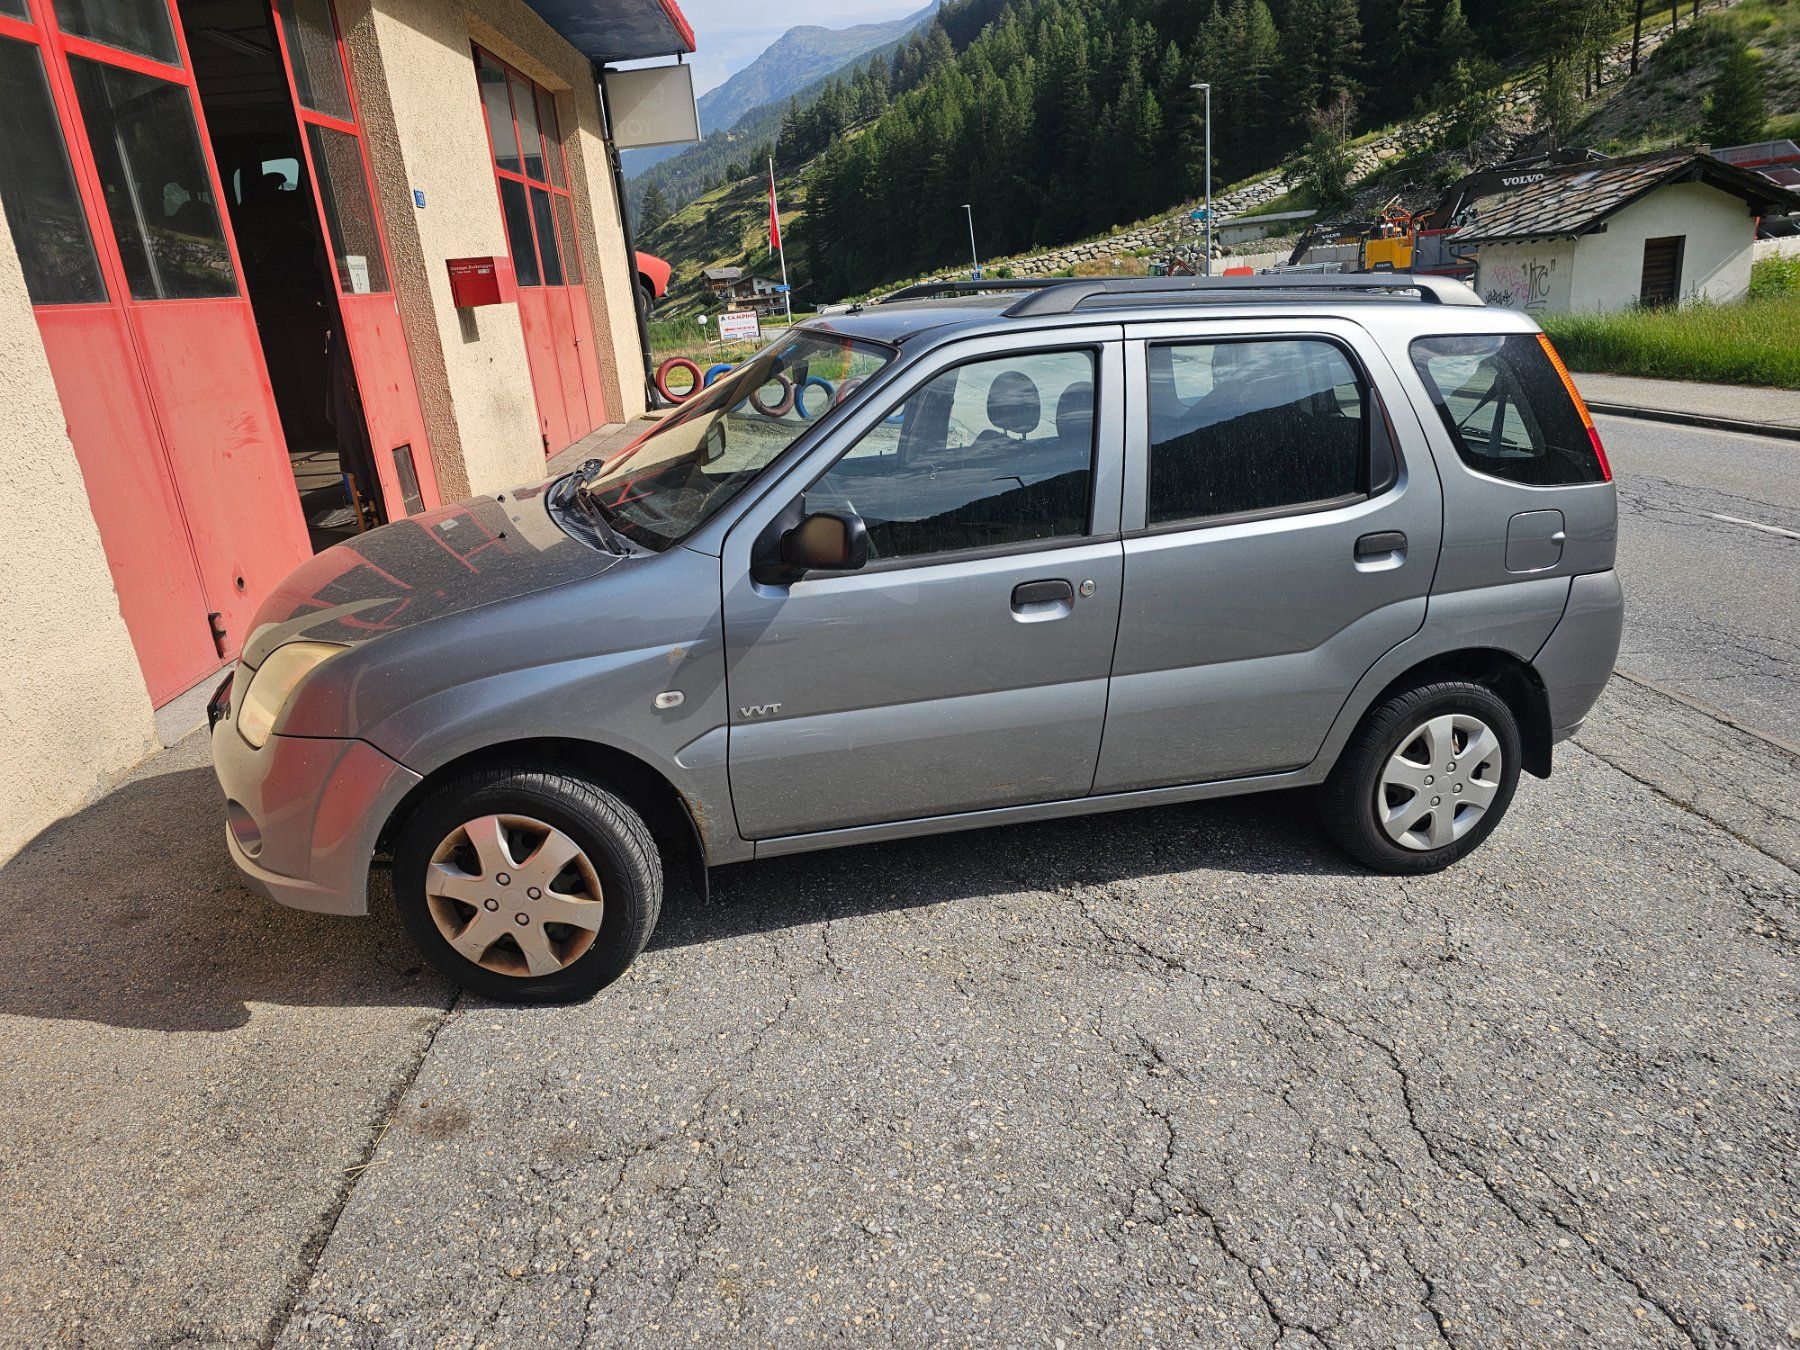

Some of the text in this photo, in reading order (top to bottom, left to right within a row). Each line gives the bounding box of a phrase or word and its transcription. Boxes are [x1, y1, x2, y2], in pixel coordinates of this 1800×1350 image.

[1502, 173, 1544, 186] VOLVO
[727, 312, 757, 321] CAMPING
[740, 703, 782, 717] VVT
